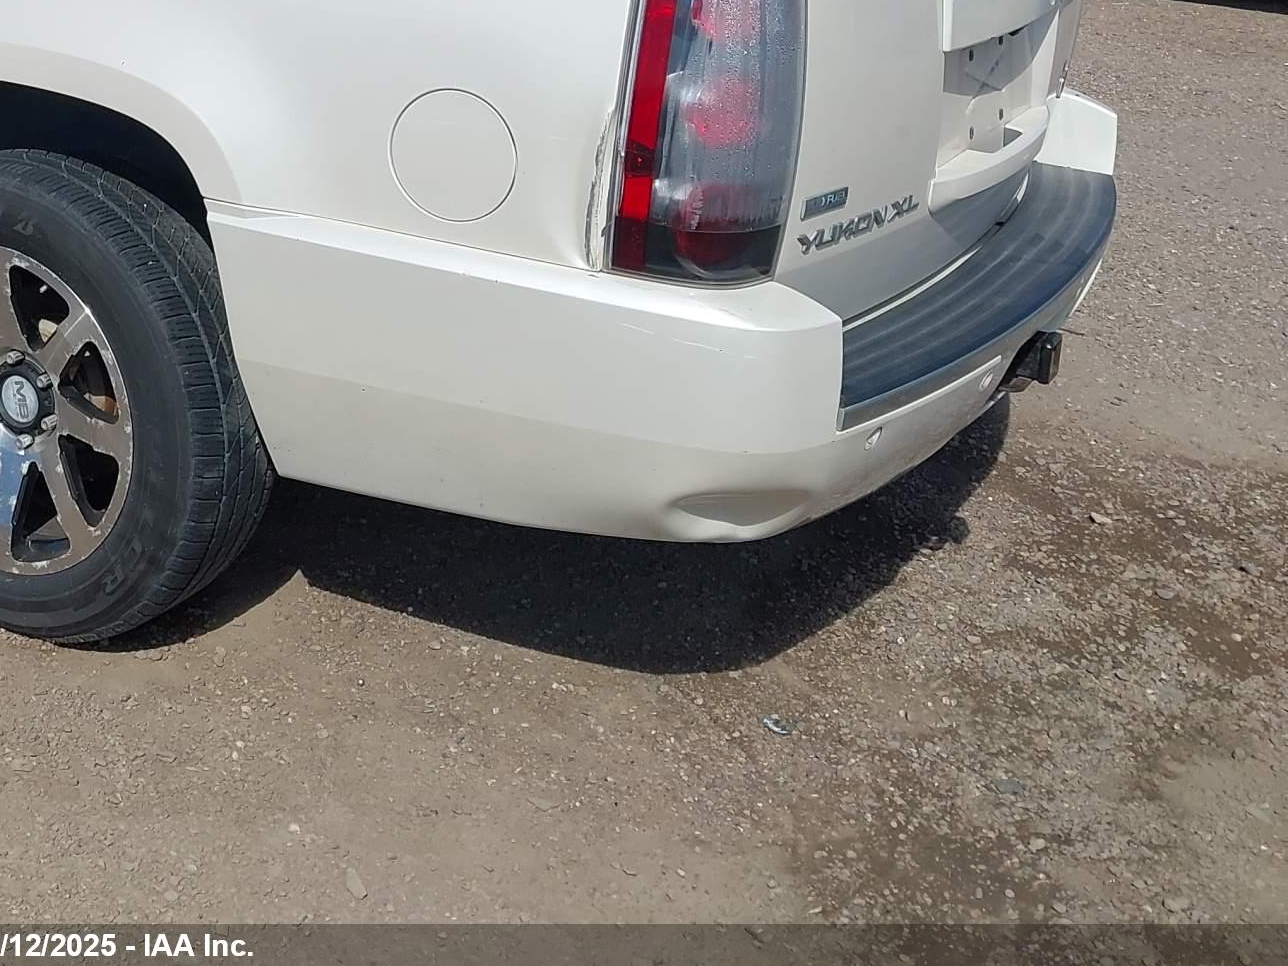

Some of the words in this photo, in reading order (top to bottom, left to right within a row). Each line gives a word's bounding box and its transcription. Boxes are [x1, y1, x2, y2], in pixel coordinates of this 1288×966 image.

[797, 205, 888, 255] YUKON
[887, 194, 920, 223] XL
[14, 380, 29, 420] MB
